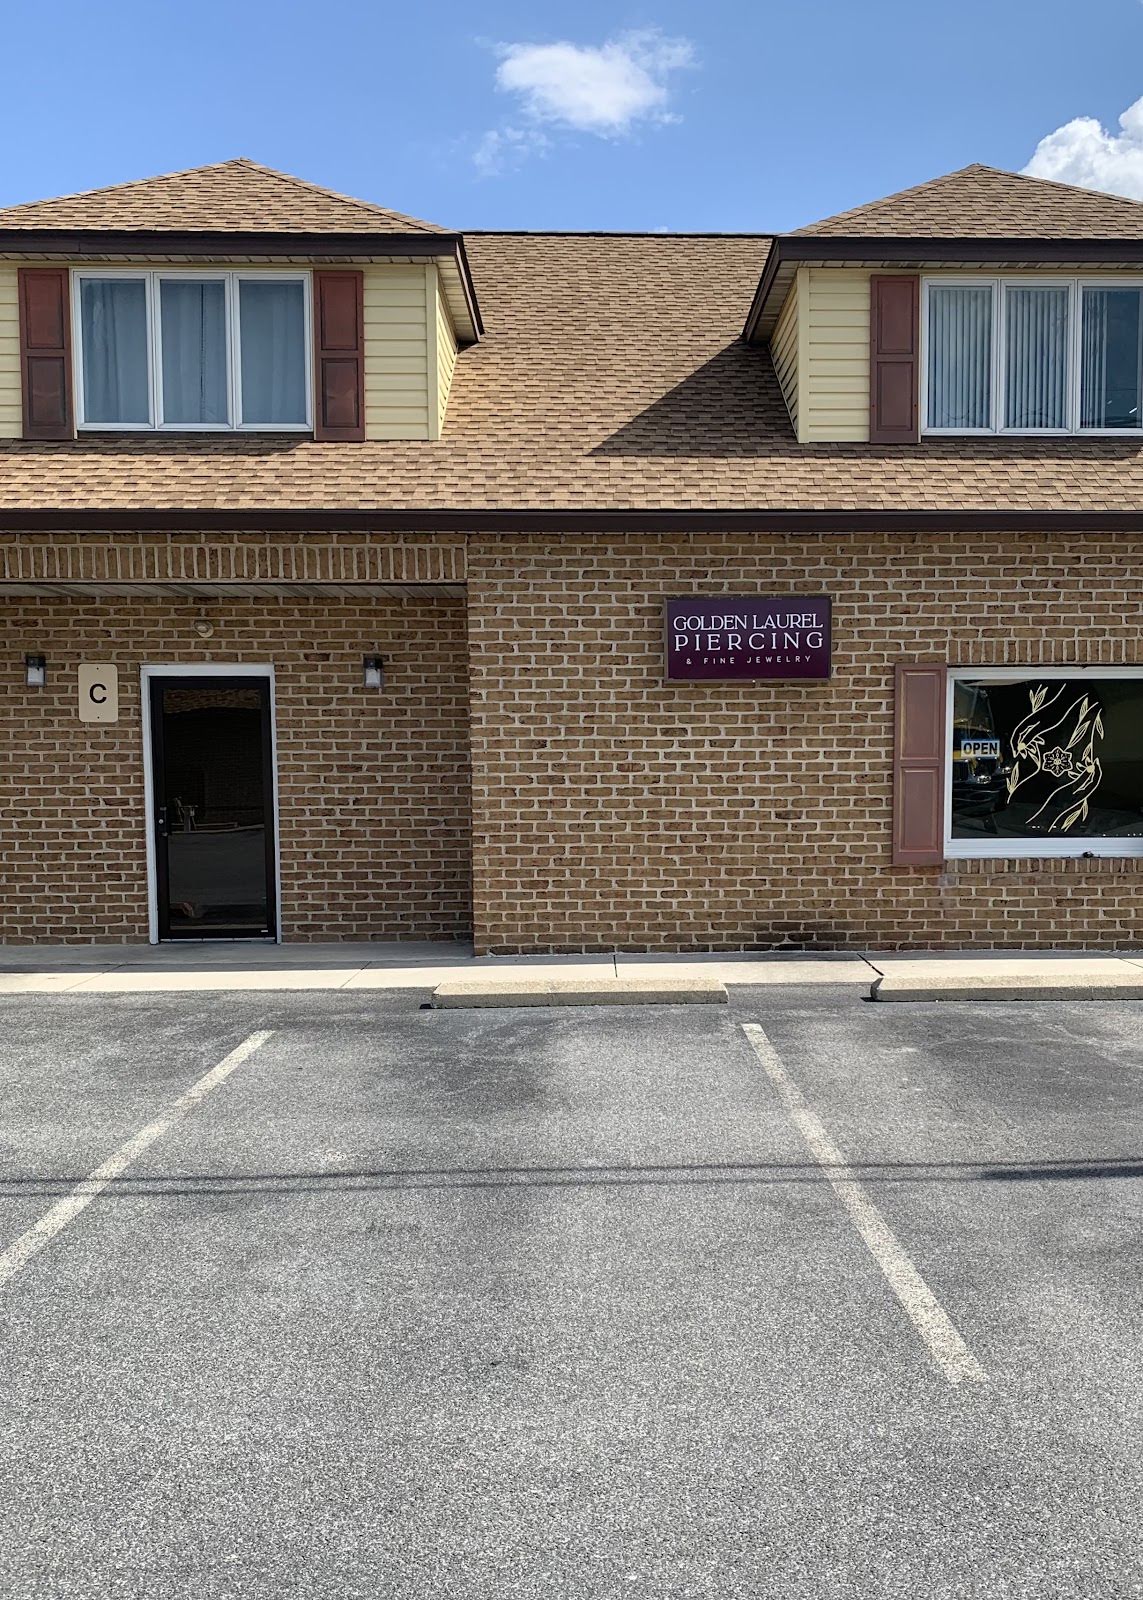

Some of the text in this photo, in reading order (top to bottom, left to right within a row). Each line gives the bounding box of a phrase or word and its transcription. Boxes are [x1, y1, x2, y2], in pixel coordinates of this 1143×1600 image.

[673, 613, 823, 631] GOLDEN LAUREL
[674, 632, 823, 651] PIERCING
[747, 655, 811, 664] JEWELRY
[89, 683, 107, 704] C
[963, 742, 997, 755] OPEN
